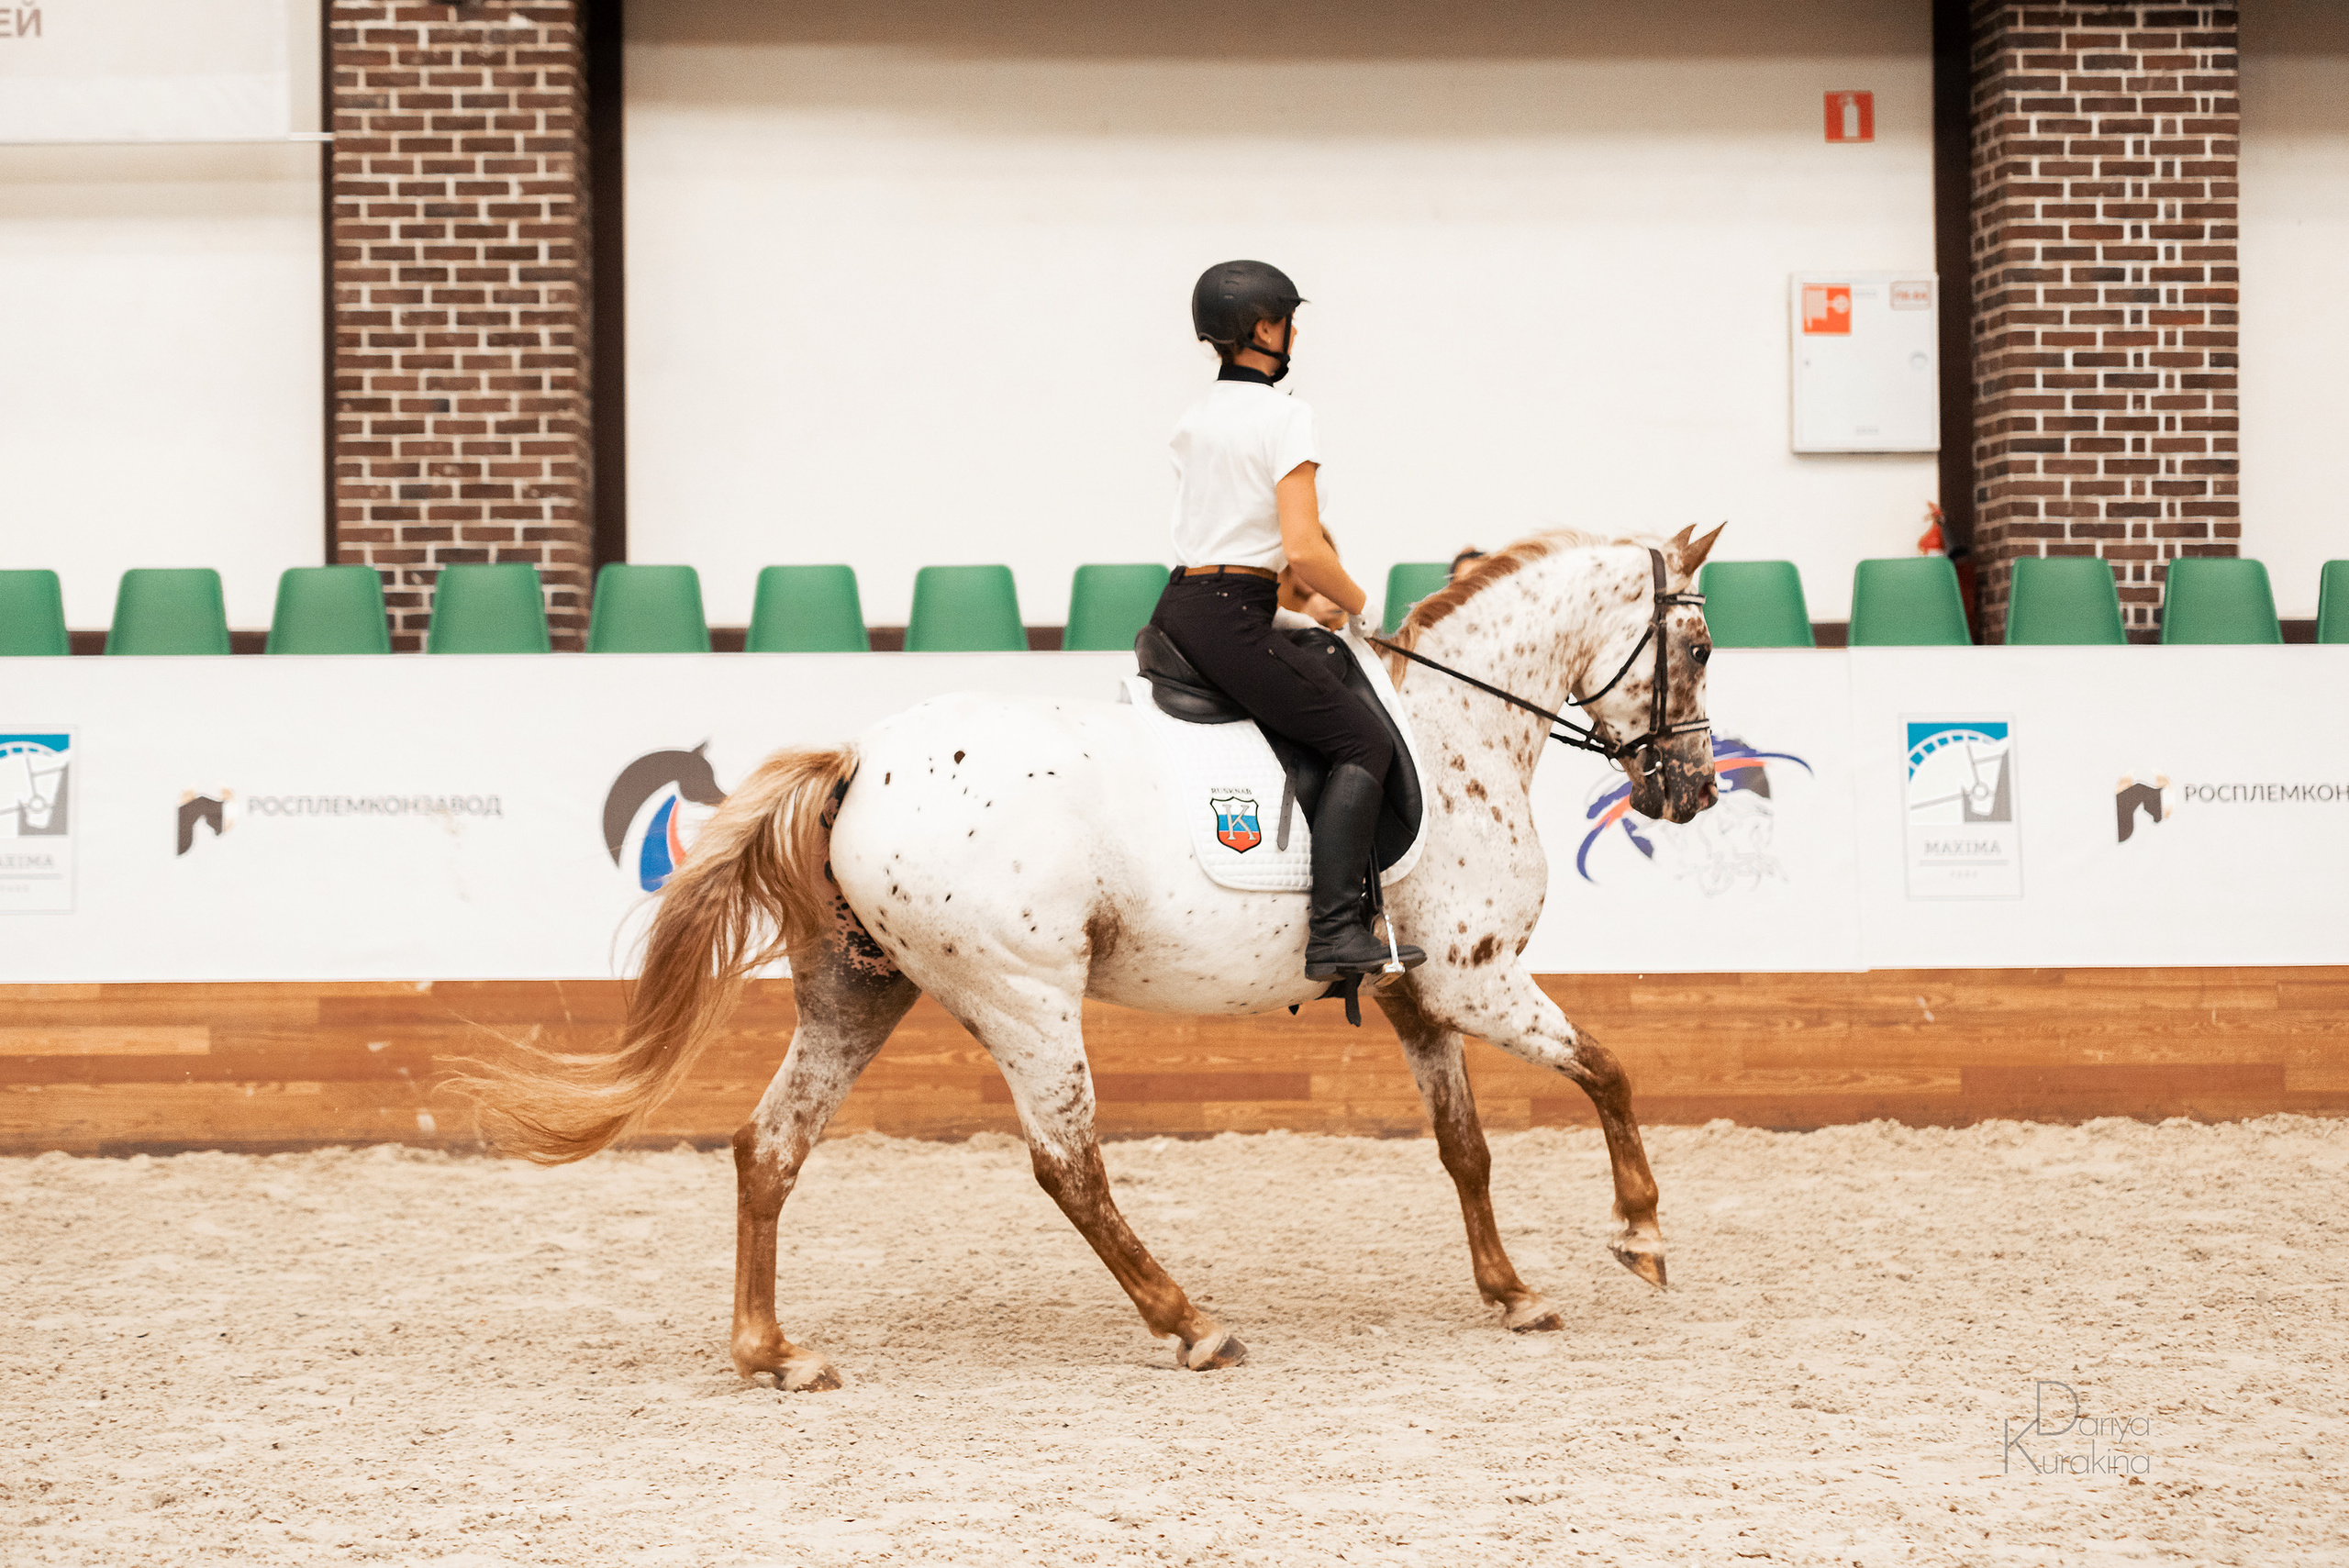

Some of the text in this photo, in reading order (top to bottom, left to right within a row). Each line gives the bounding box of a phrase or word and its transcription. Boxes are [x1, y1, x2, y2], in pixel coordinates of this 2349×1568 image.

[2184, 784, 2349, 803] РОСПЛЕМКОН
[247, 795, 503, 817] РОСПЛЕМКОНЗАВОД
[1222, 804, 1257, 841] K
[1923, 840, 2002, 856] MAXIMA
